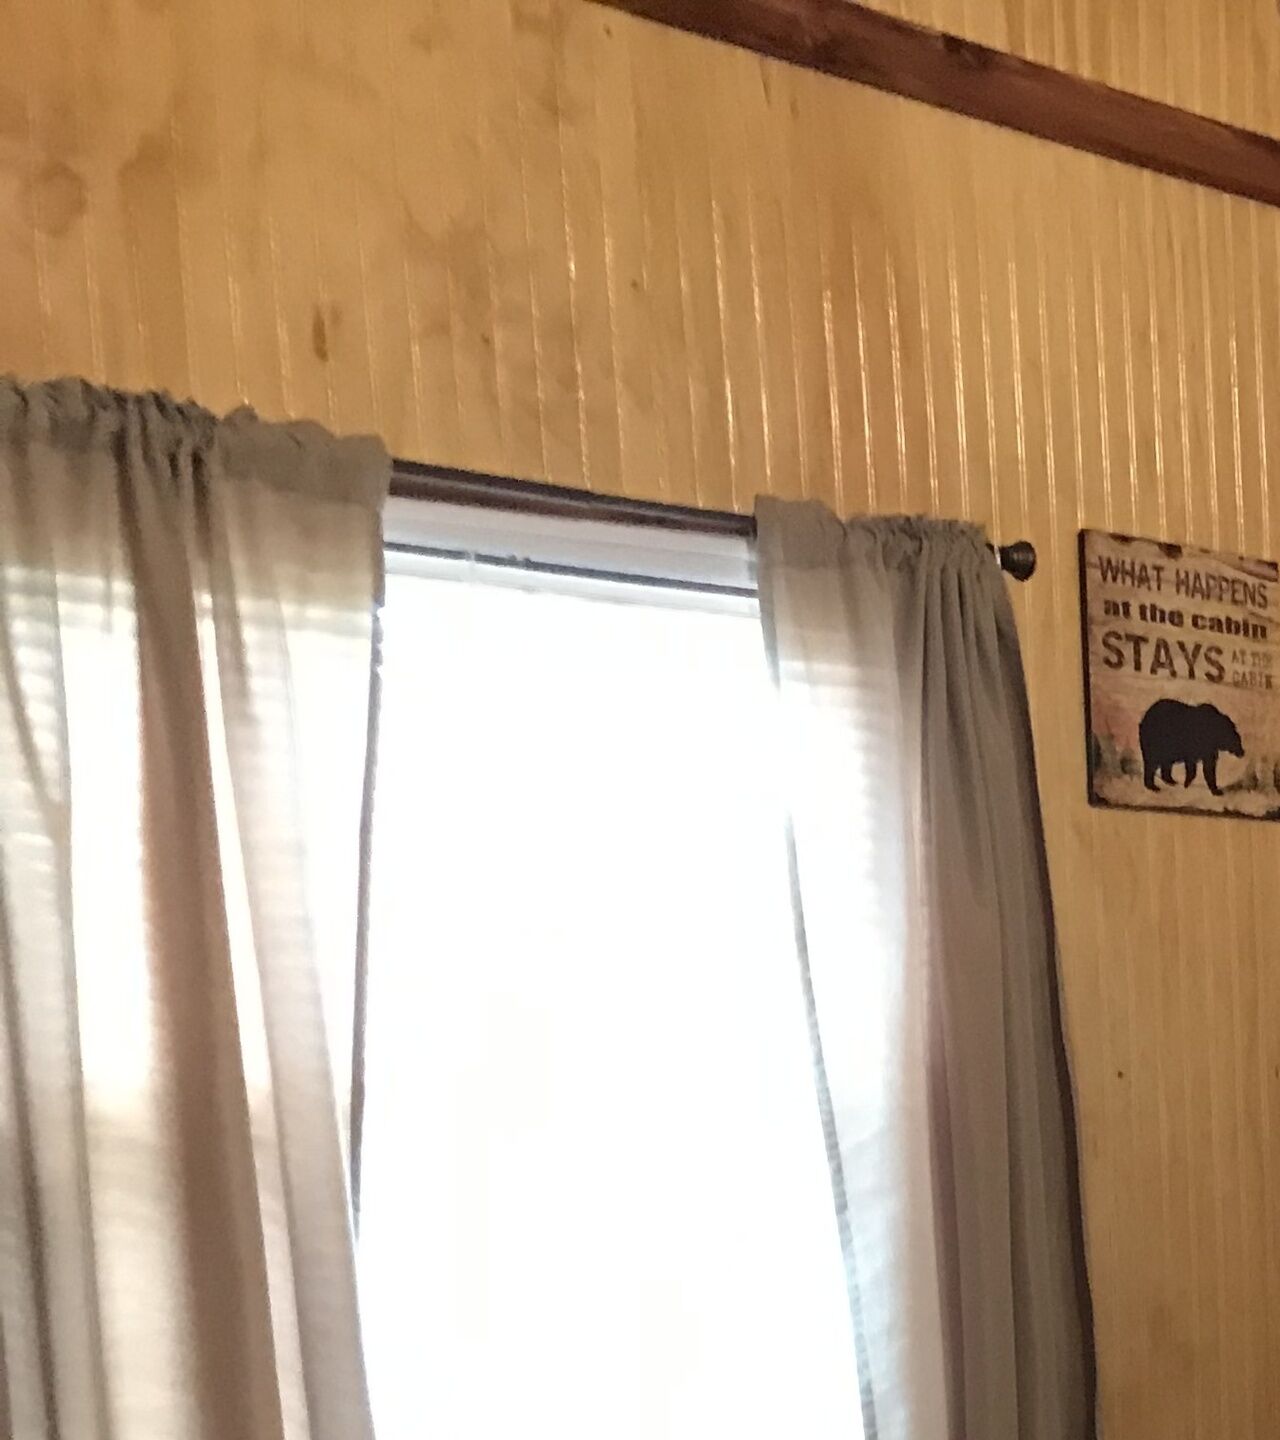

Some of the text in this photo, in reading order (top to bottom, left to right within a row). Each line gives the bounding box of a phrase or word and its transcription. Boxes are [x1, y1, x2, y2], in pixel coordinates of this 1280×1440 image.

[1098, 555, 1269, 610] WHAT HAPPENS
[1103, 600, 1268, 640] at the cabin
[1100, 630, 1226, 683] STAYS
